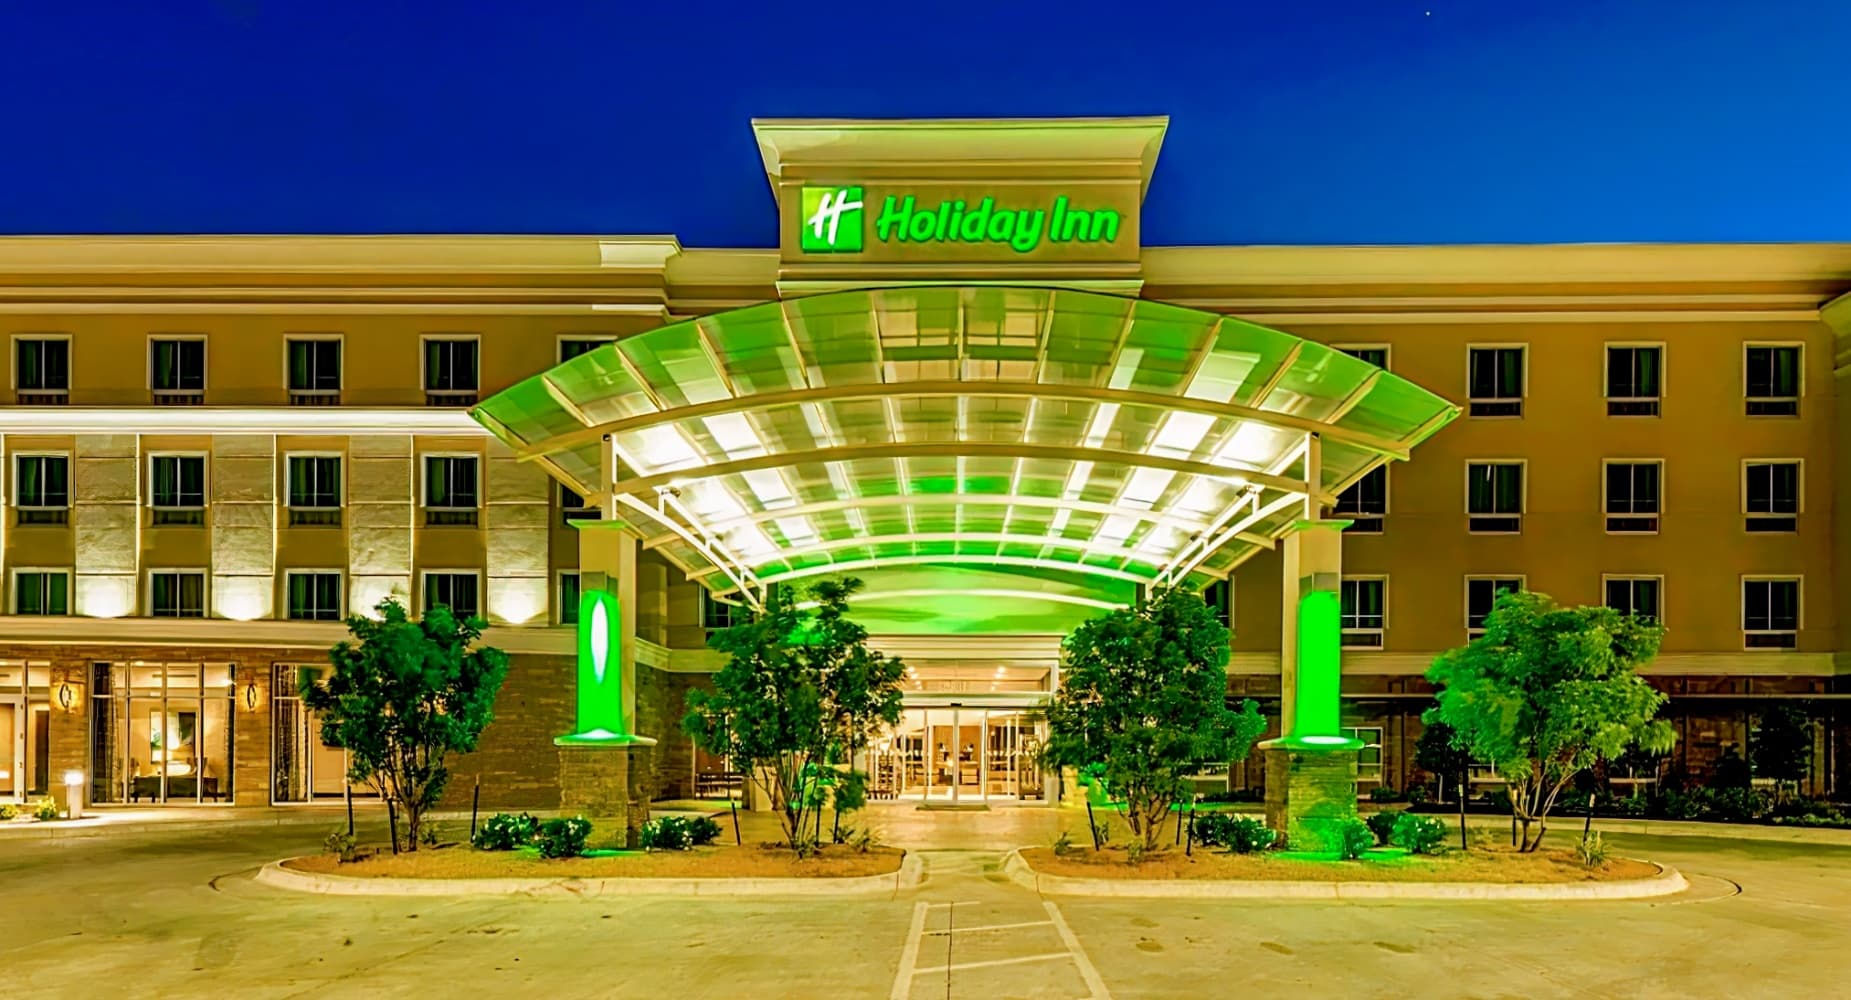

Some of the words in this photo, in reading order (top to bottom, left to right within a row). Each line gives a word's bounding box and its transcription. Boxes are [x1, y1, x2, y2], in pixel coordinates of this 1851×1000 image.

[808, 190, 863, 245] H
[876, 195, 1045, 252] Holiday
[1049, 195, 1120, 242] Inn
